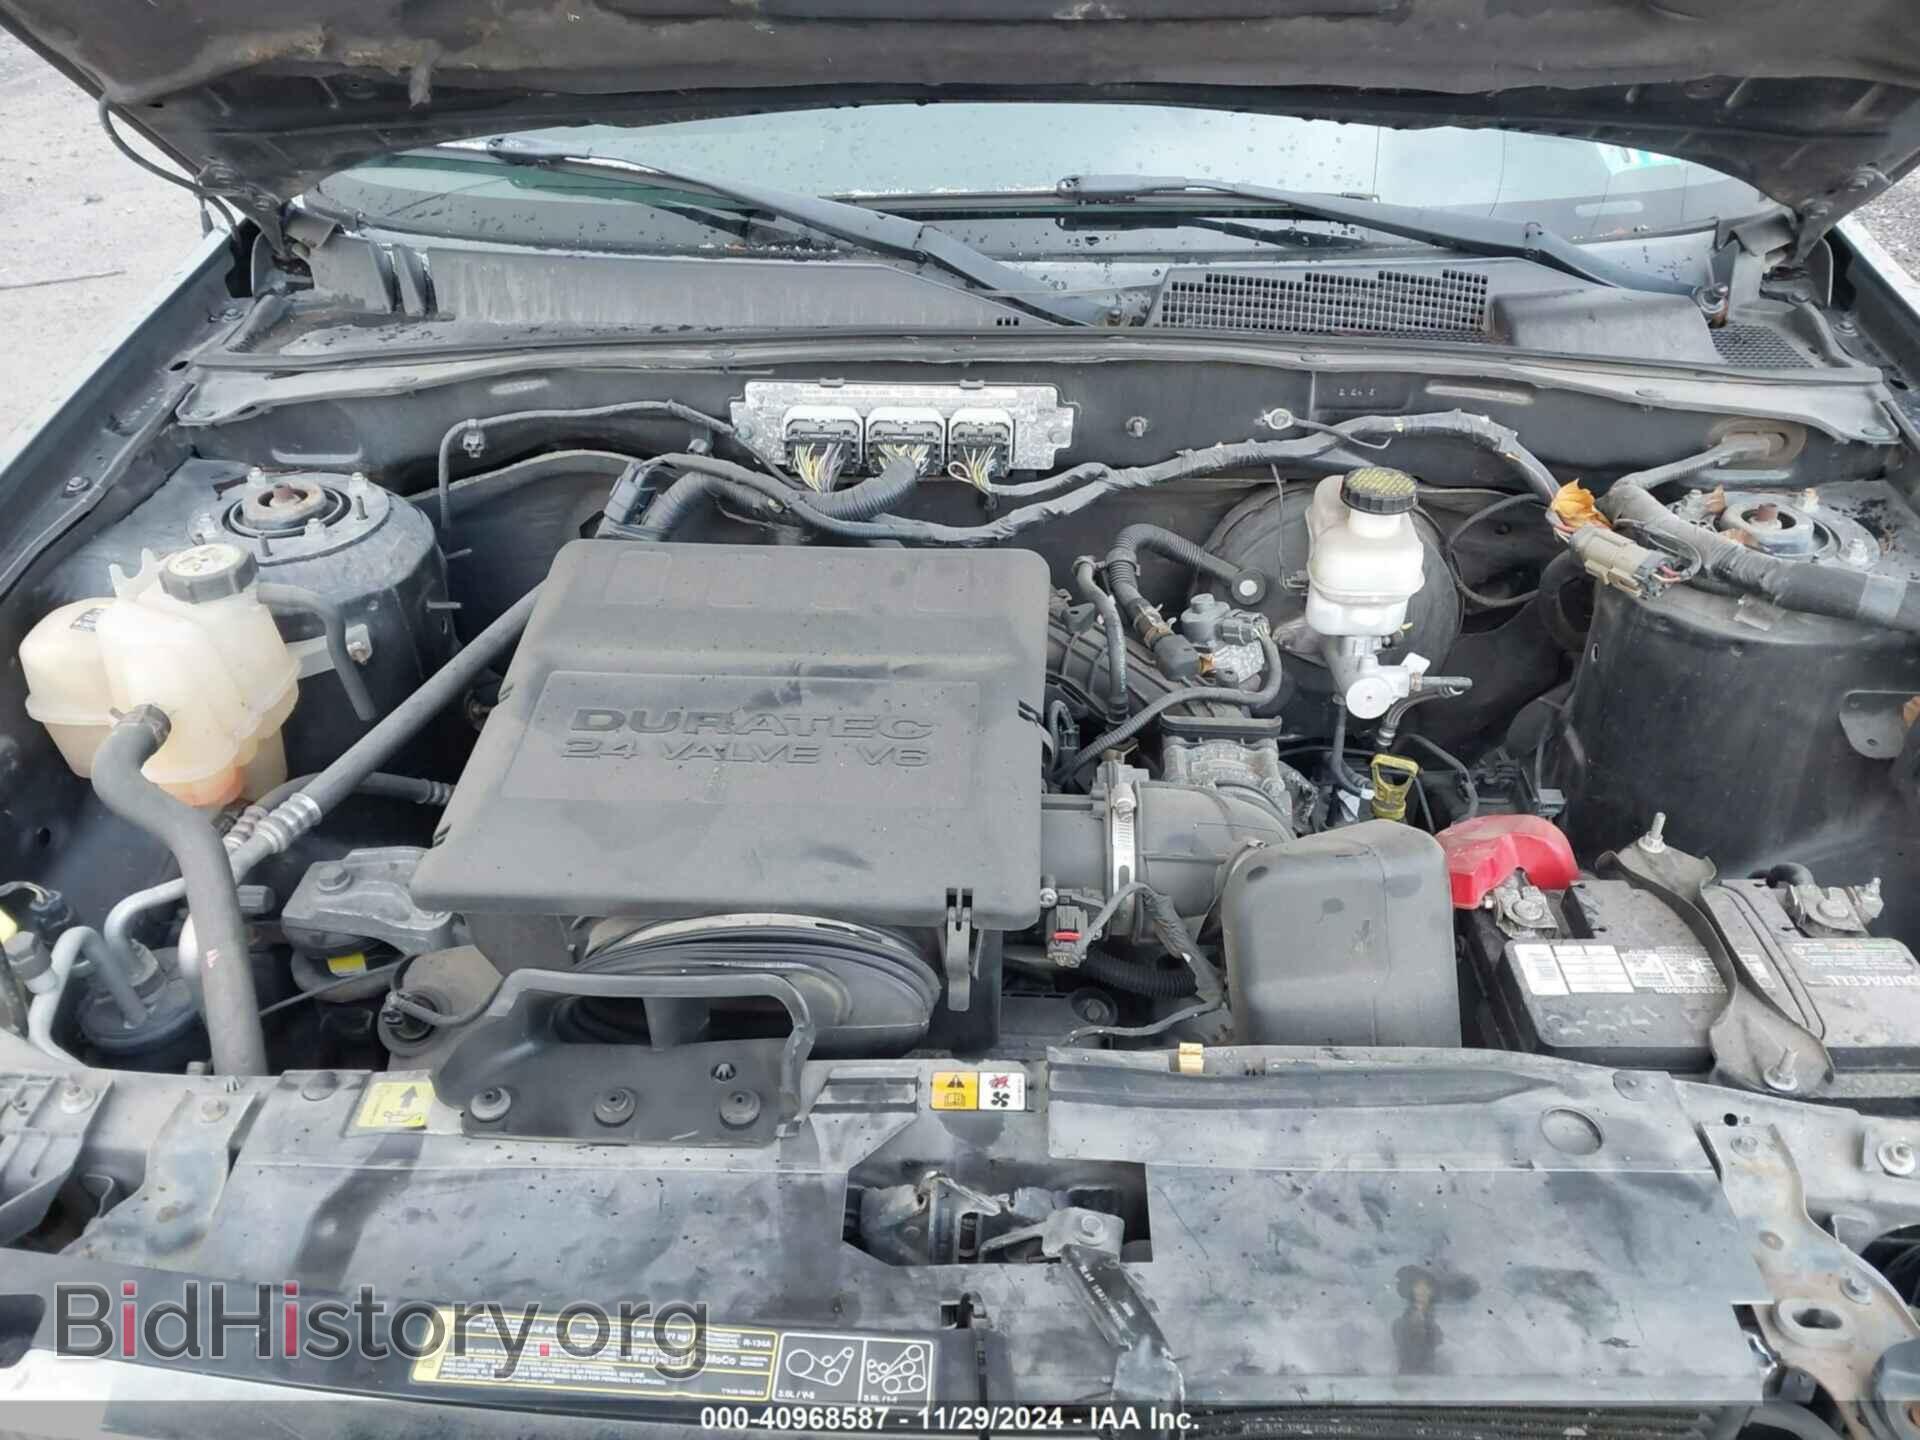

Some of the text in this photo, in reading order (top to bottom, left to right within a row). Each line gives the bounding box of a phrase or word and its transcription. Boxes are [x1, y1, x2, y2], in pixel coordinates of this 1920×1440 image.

[570, 707, 936, 740] DURATEC
[561, 737, 931, 768] 24 VALVE V6
